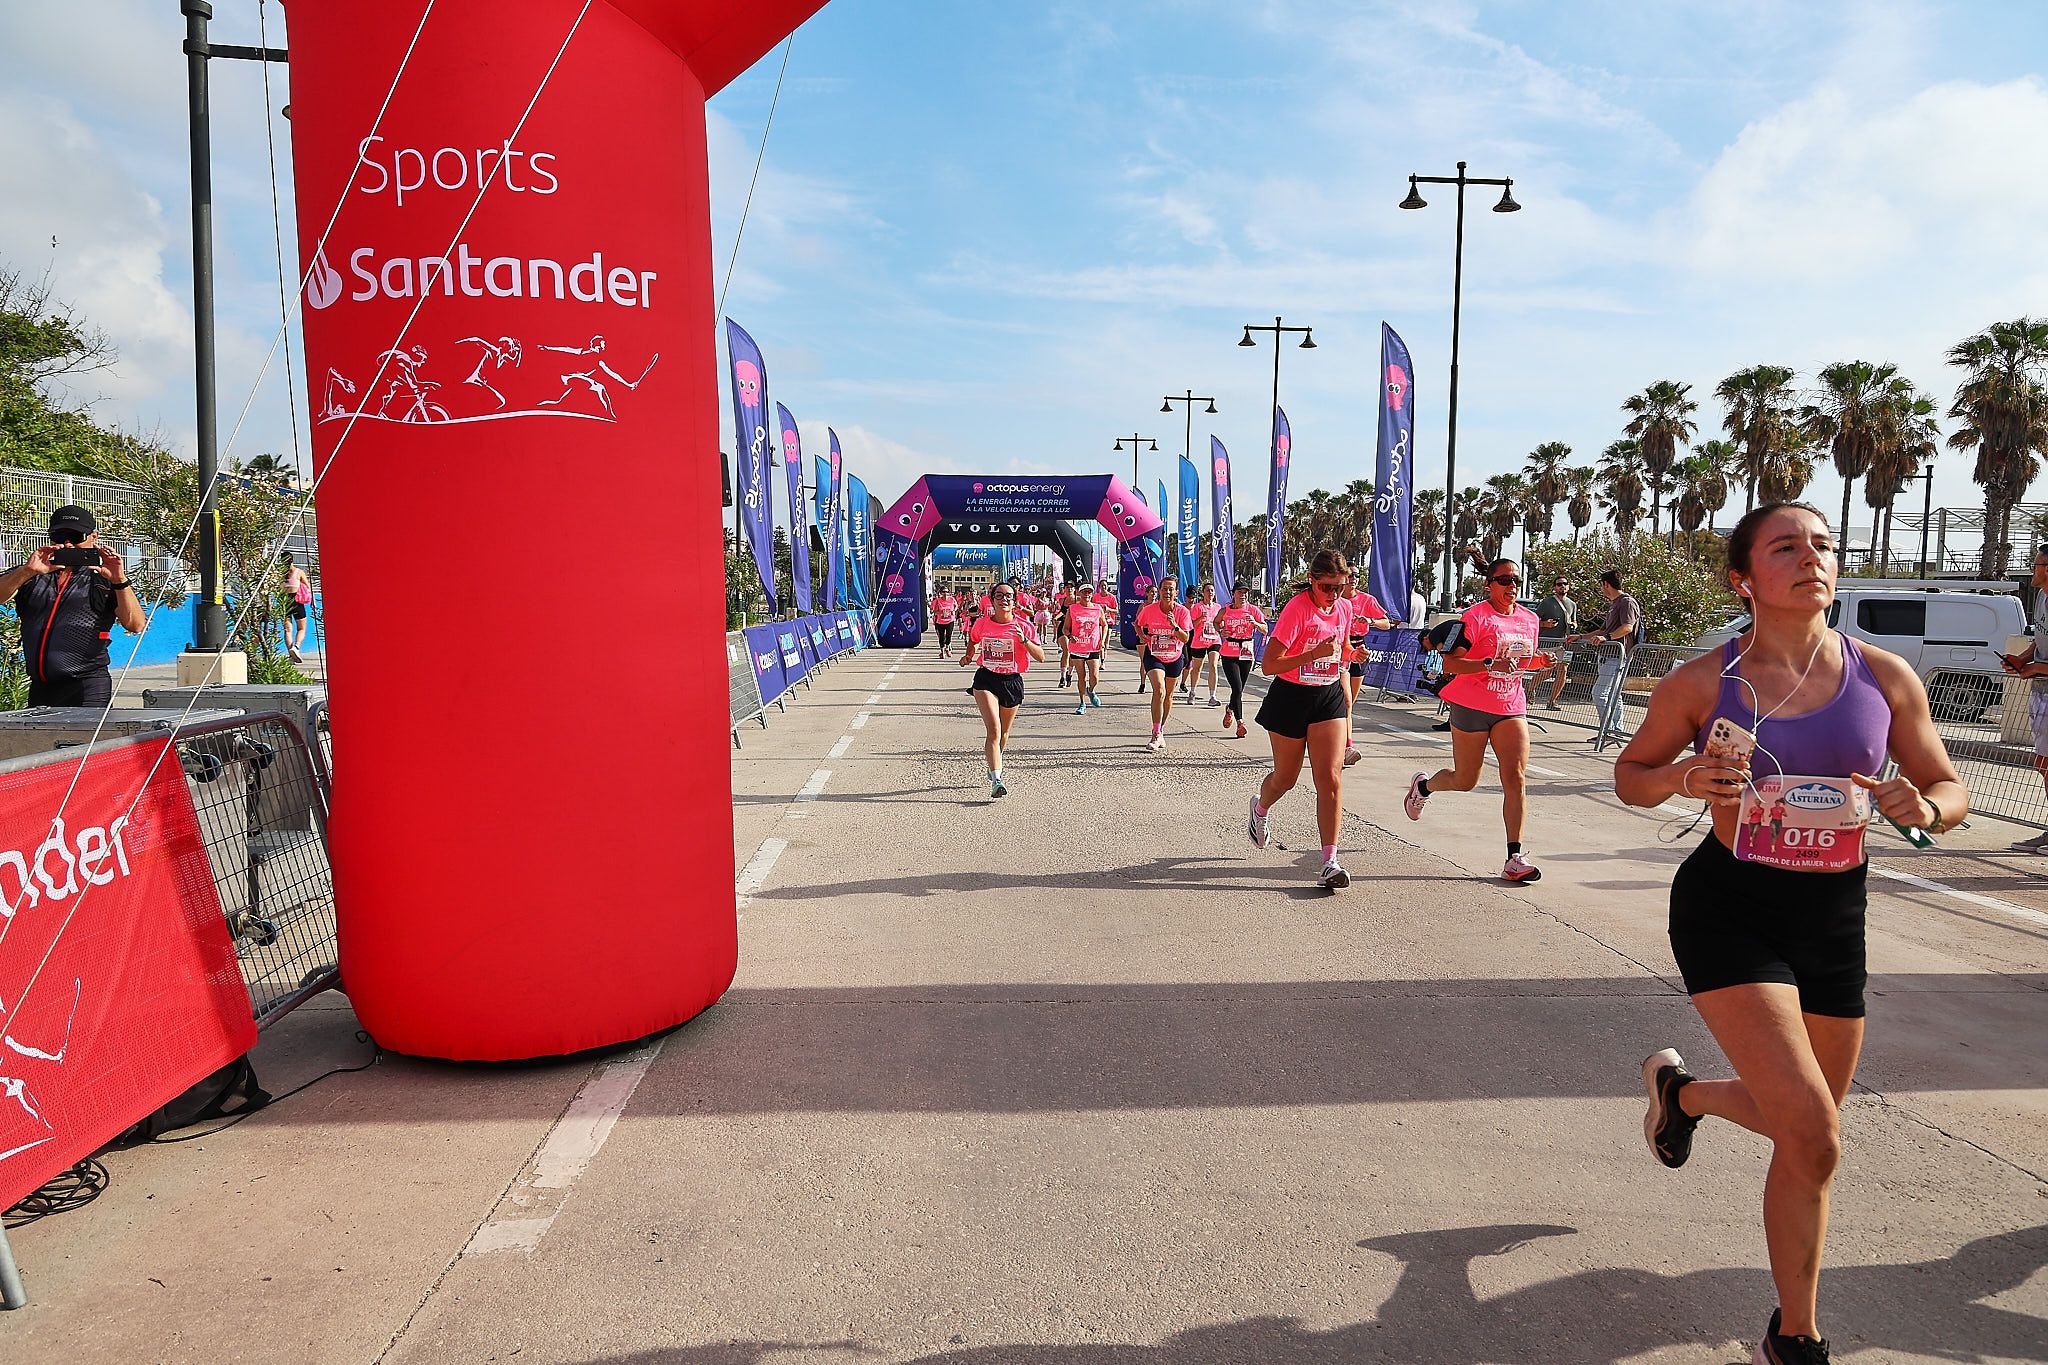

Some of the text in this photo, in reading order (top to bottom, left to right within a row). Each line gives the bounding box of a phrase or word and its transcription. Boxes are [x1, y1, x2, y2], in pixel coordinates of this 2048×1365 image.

[358, 135, 559, 206] Sports
[350, 243, 658, 309] Santander
[978, 497, 1012, 505] ENERGÍA
[949, 523, 1039, 534] VOLVO
[1789, 792, 1841, 804] ASTURIANA
[1783, 828, 1836, 848] 016
[1748, 853, 1779, 864] CARRERA
[1795, 850, 1820, 858] 2499
